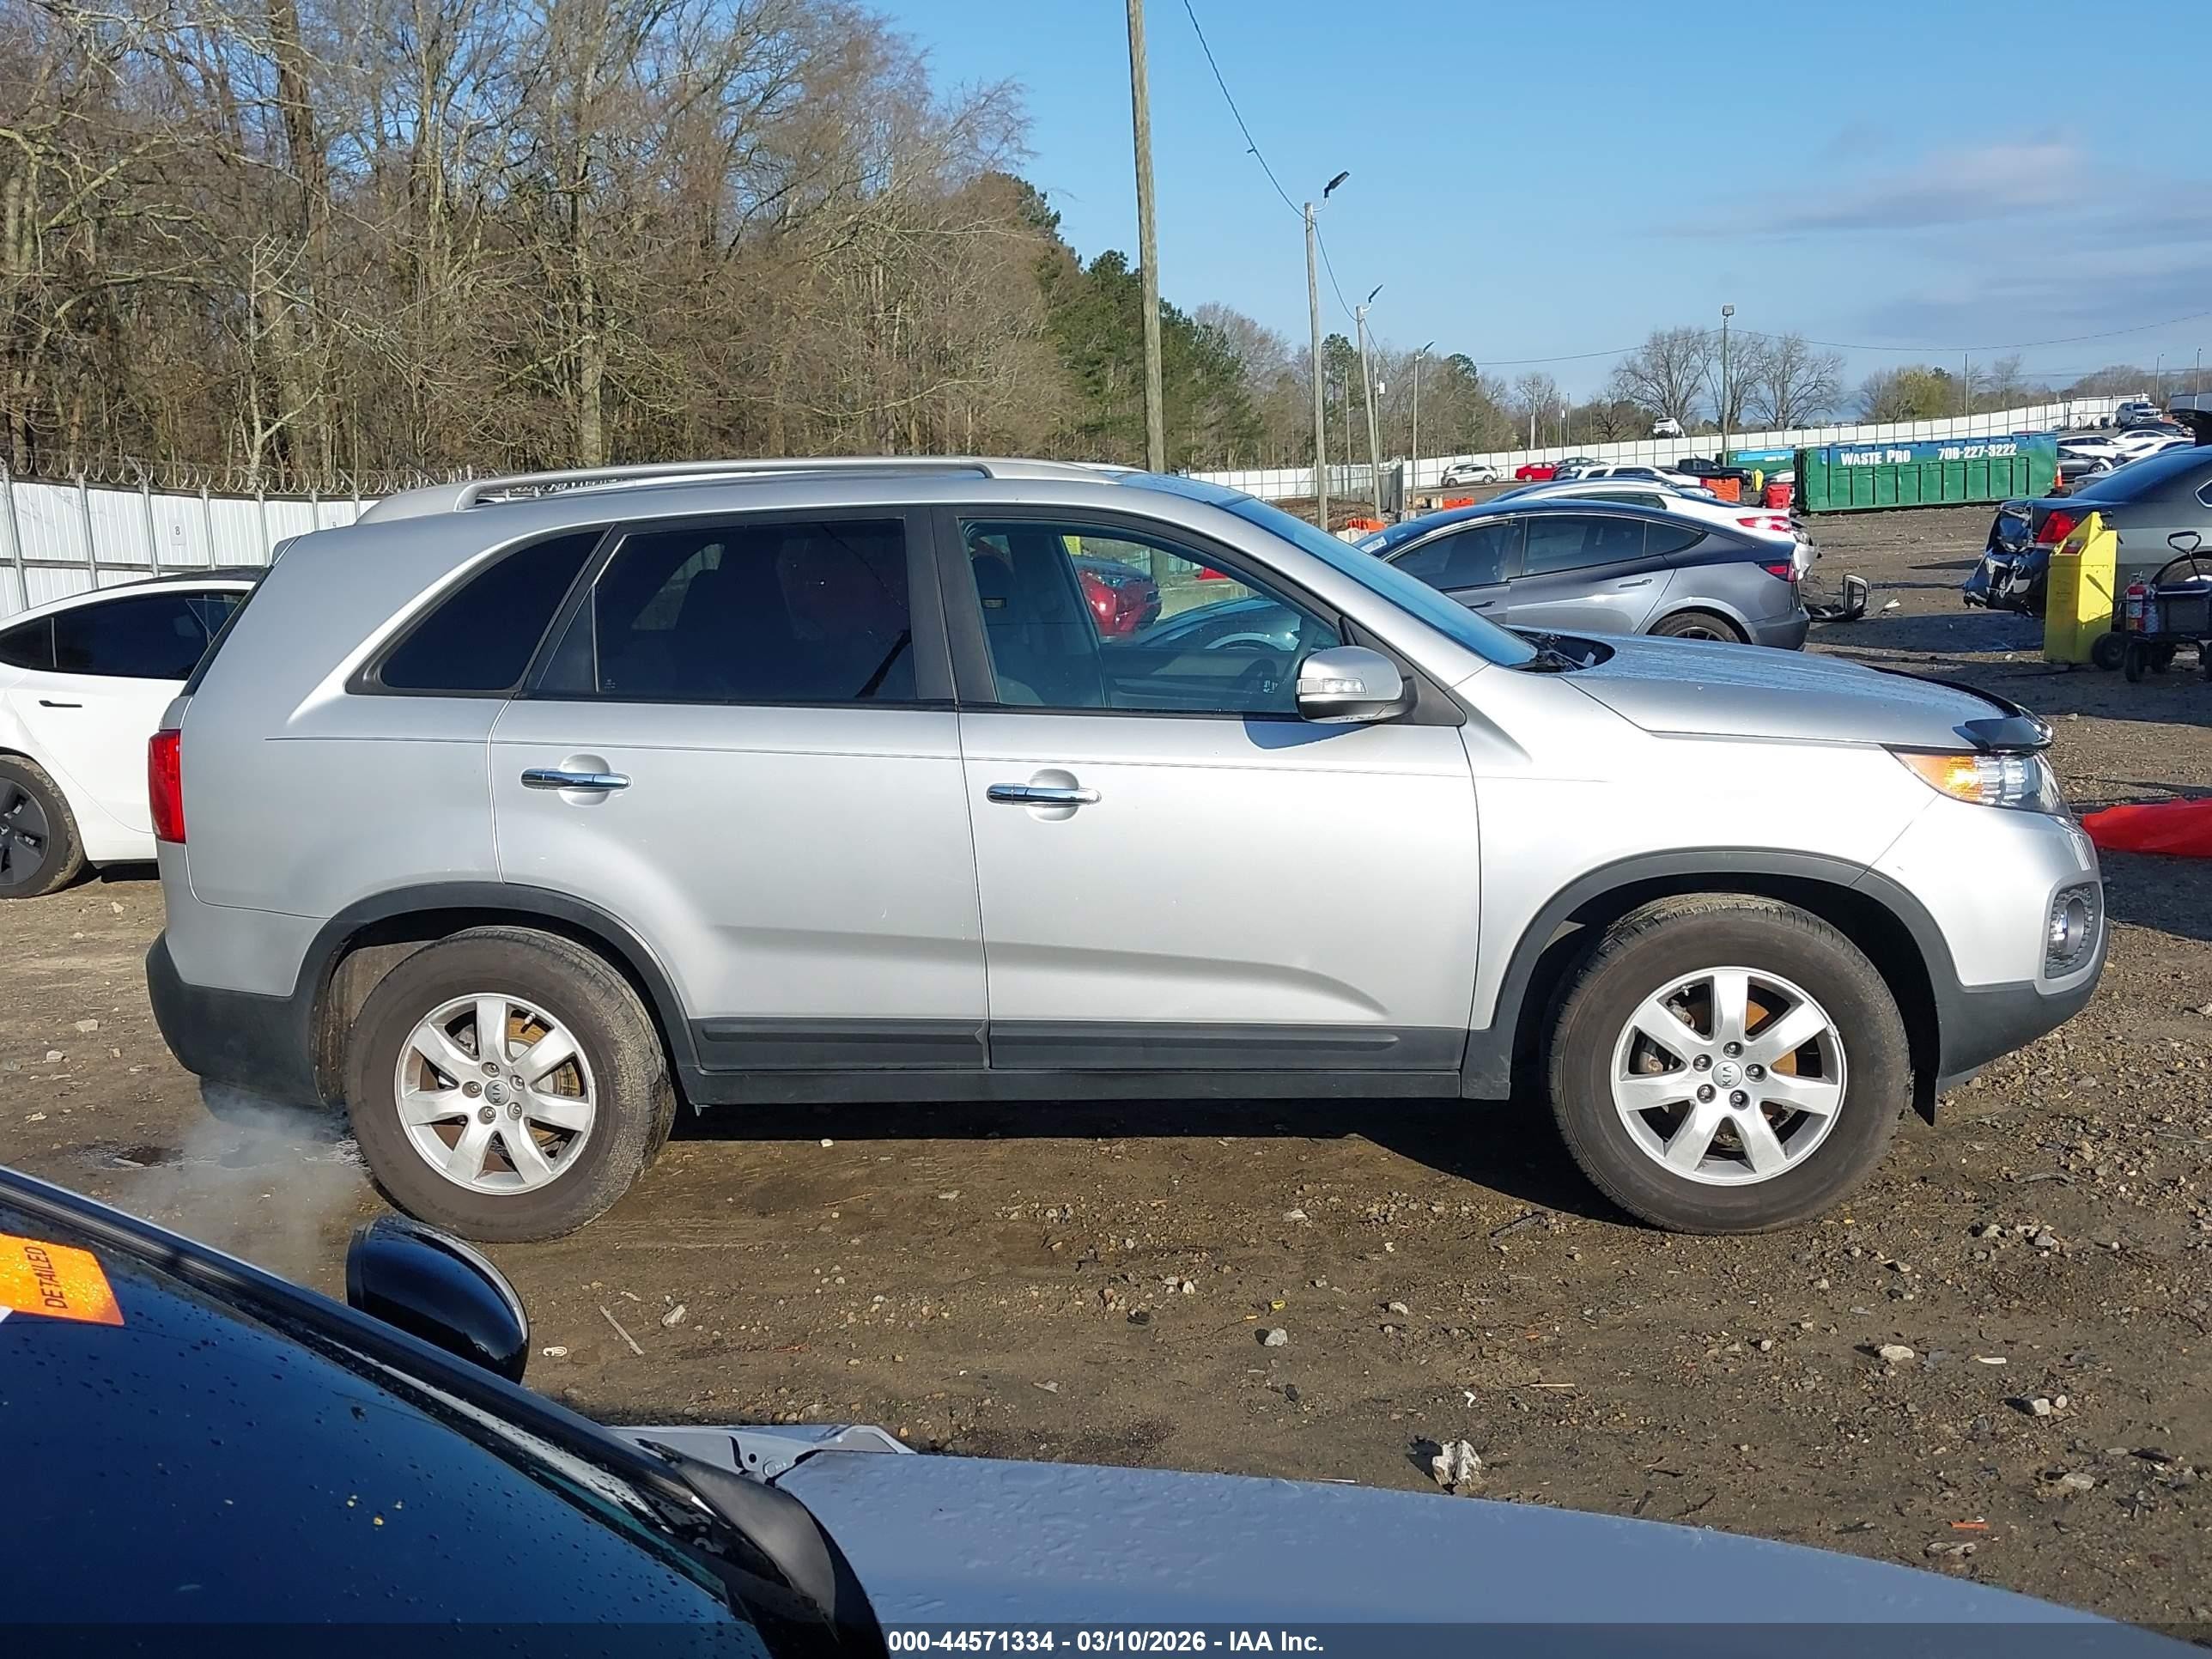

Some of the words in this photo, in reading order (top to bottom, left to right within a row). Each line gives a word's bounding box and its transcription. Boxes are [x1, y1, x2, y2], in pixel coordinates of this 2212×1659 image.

[1840, 452, 1882, 465] WASTE
[1887, 449, 1911, 464] PRO
[1723, 1066, 1732, 1087] KIA
[492, 1084, 501, 1103] KIA
[24, 1246, 69, 1310] DETAILED
